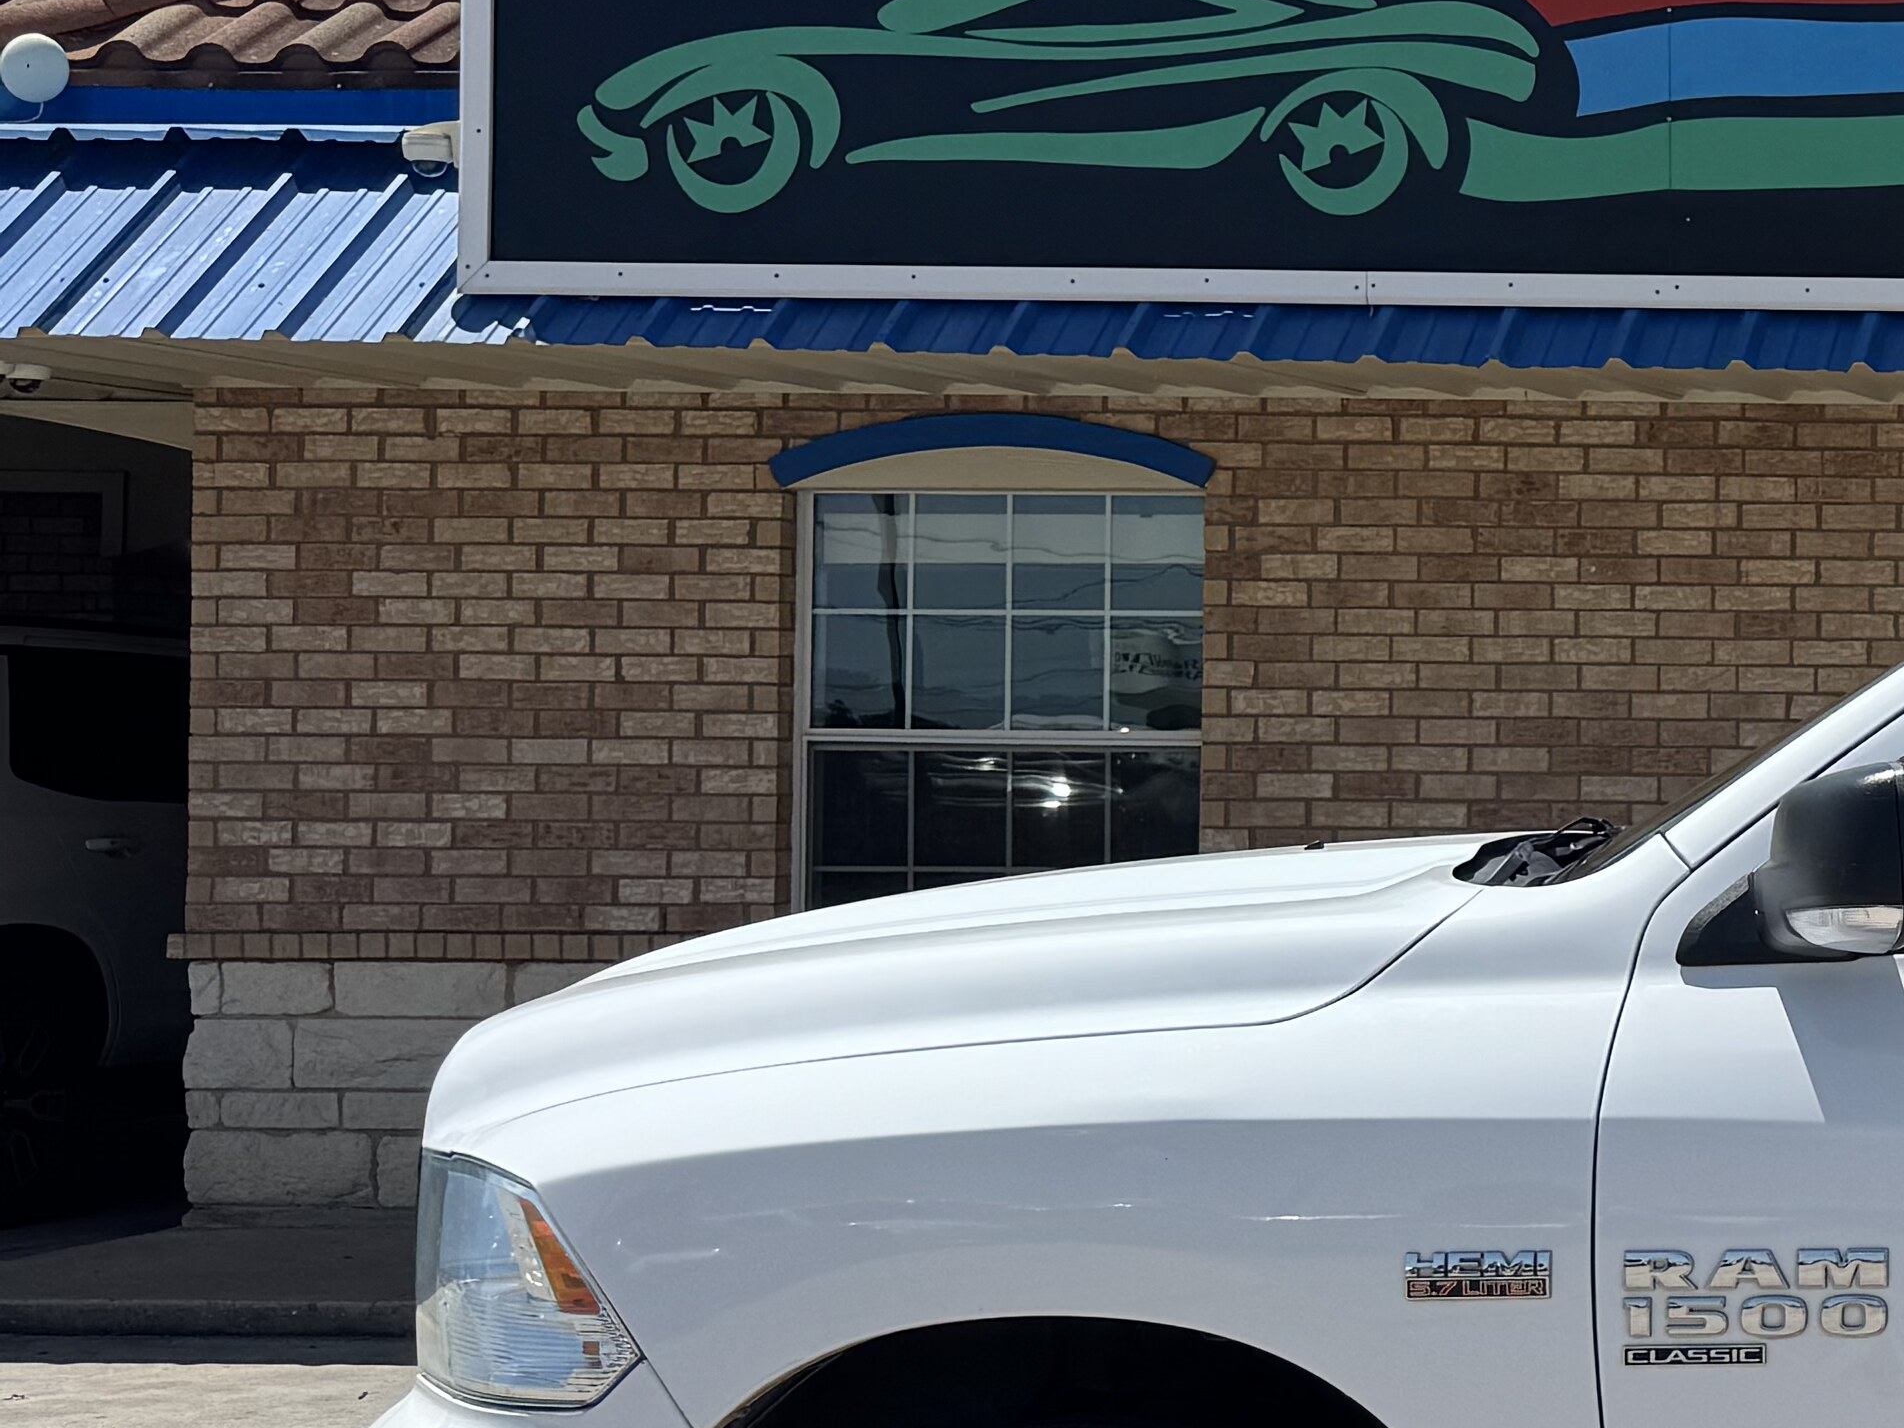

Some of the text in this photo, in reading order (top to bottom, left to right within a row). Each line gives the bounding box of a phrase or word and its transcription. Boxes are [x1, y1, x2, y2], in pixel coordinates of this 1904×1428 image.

[1404, 1249, 1553, 1277] HEMI
[1623, 1247, 1890, 1290] RAM
[1408, 1279, 1545, 1297] 5.7 LITER
[1622, 1293, 1889, 1339] 1500
[1626, 1347, 1763, 1365] CLASSIC
